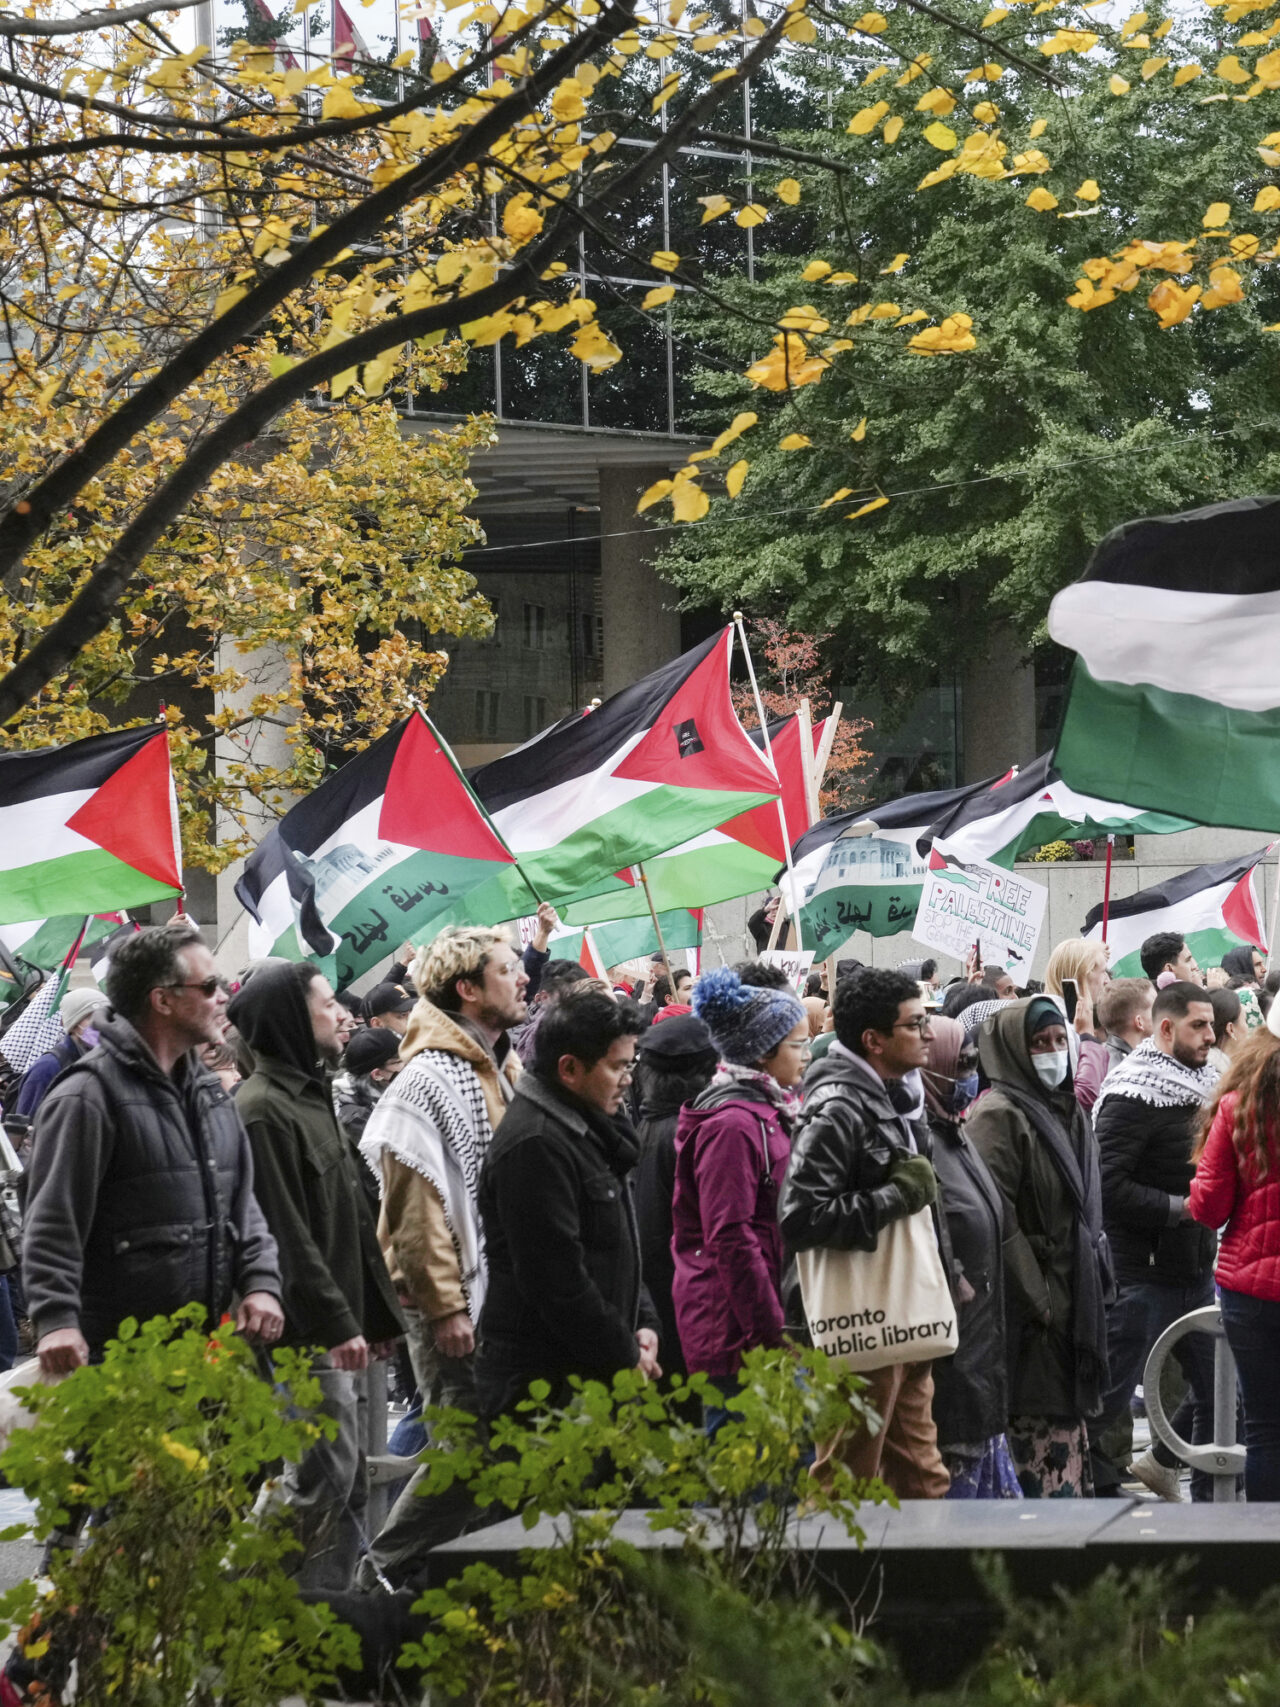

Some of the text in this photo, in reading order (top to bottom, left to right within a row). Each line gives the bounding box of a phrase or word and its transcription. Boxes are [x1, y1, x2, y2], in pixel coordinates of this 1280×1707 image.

[978, 870, 1032, 916] FREE
[925, 909, 974, 939] STOP THE
[928, 882, 1036, 951] PALESTINE
[811, 1308, 886, 1336] toronto
[816, 1320, 953, 1357] ublic library
